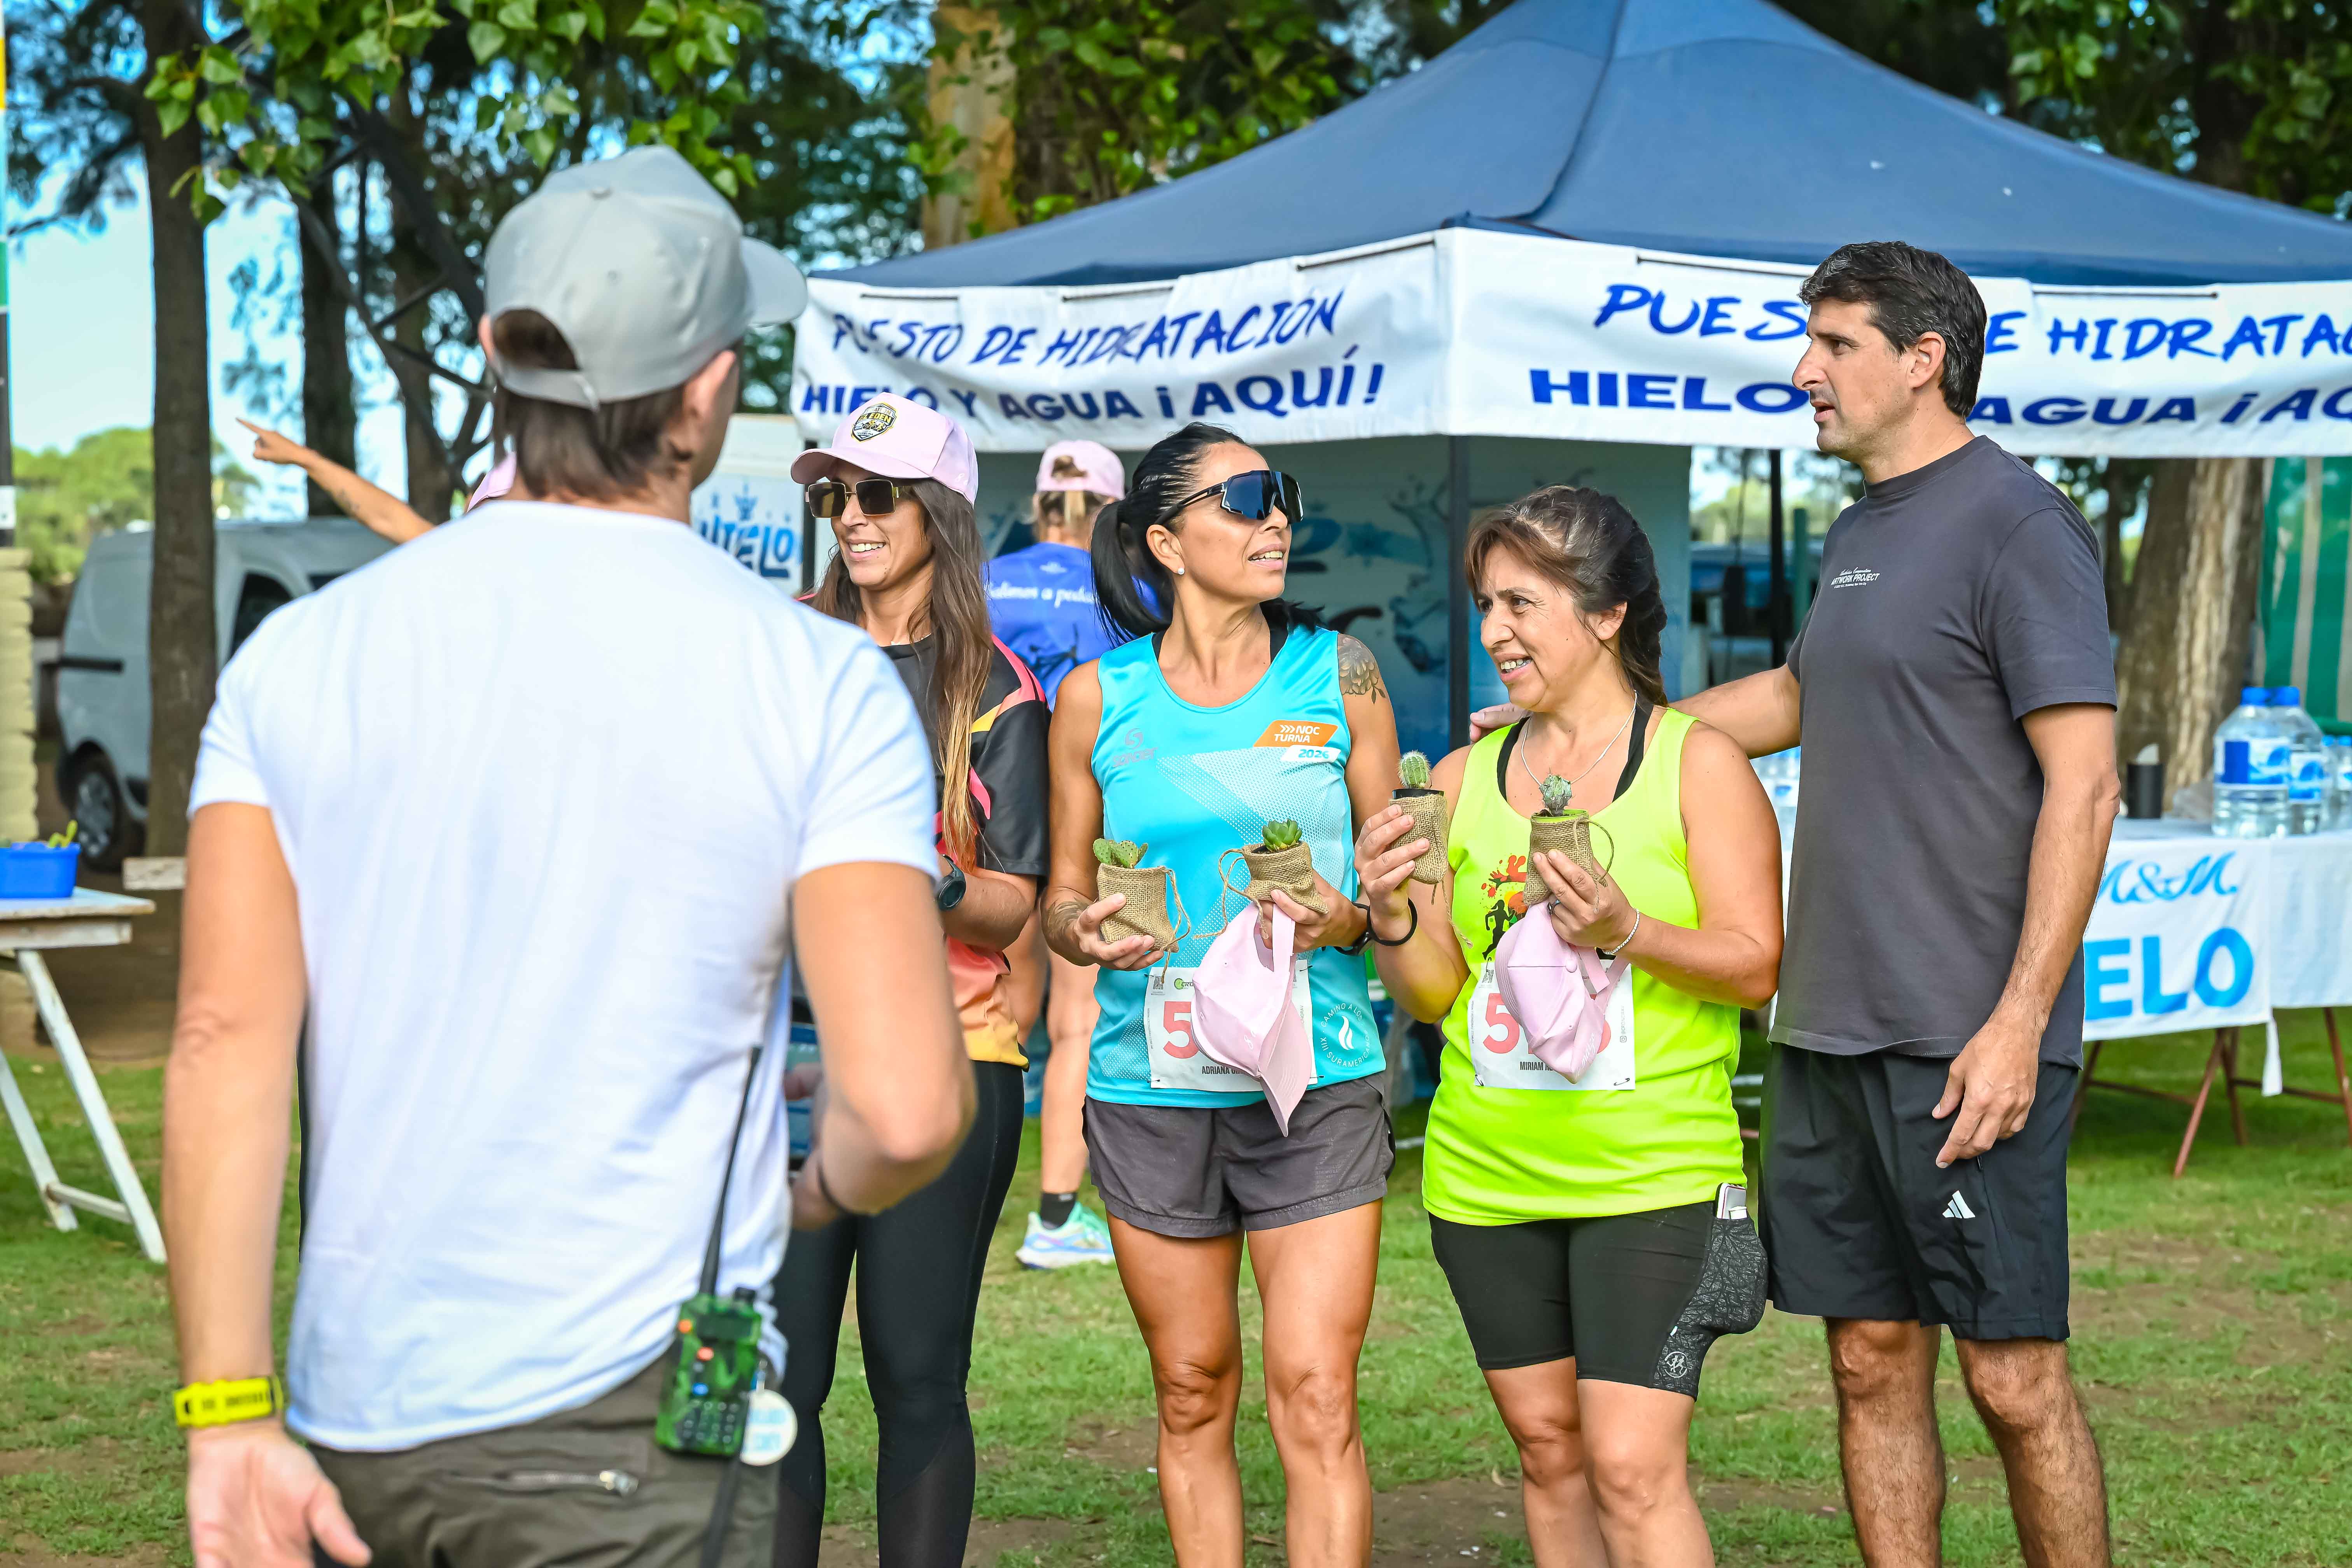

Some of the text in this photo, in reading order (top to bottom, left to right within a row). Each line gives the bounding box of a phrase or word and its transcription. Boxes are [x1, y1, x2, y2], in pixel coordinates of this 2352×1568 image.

[1595, 284, 1808, 341] PUES
[1984, 311, 2027, 354] E
[969, 324, 1037, 366] DE
[1530, 369, 1810, 413] HIELO
[1966, 397, 2195, 425] AGUA
[950, 389, 976, 417] Y
[998, 390, 1143, 421] AGUA
[868, 413, 892, 424] EDEN
[1853, 573, 1880, 582] PROJECT
[1296, 725, 1320, 735] NOC
[1274, 734, 1310, 743] TURNA
[1298, 749, 1330, 759] 2026
[2084, 927, 2254, 1022] ELO
[1321, 1003, 1346, 1027] CAMINO
[1353, 1006, 1363, 1021] LOS
[1320, 1037, 1329, 1051] XIII
[1202, 1066, 1230, 1074] ADRIANA
[1520, 1061, 1544, 1071] MIRIAM
